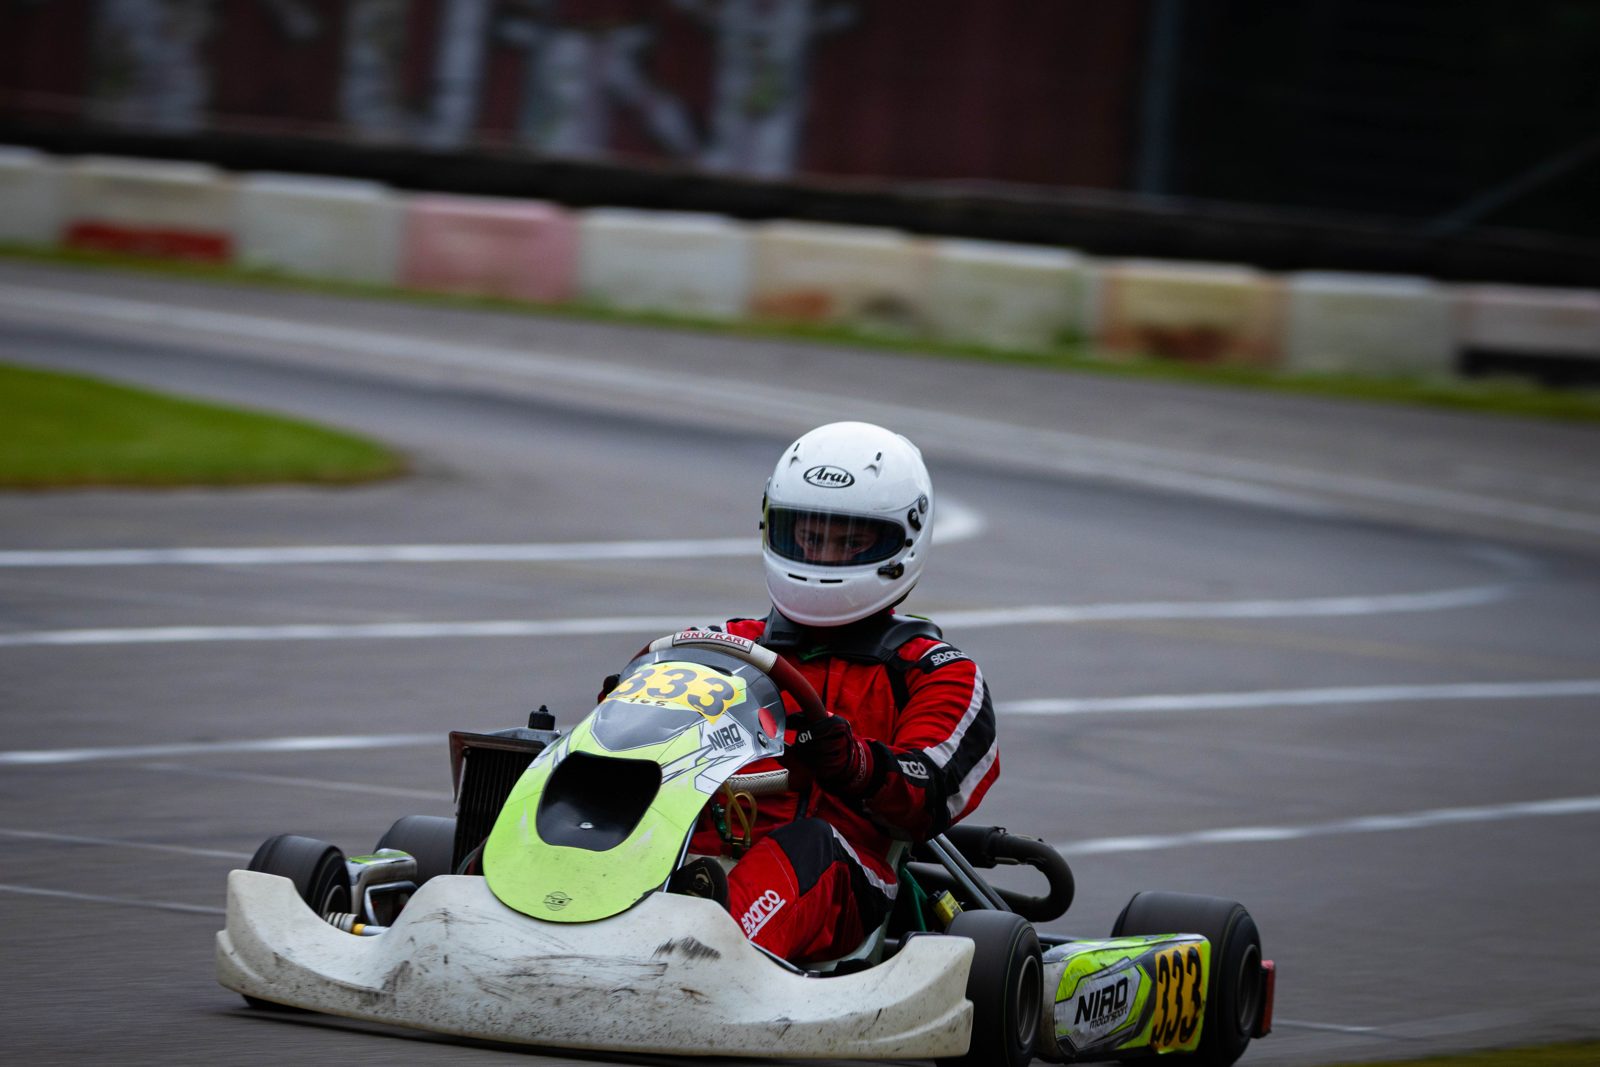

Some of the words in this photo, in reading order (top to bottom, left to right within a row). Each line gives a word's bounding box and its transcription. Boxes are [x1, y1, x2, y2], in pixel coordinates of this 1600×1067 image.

[806, 467, 849, 483] Arai
[607, 668, 735, 717] 333
[707, 723, 741, 751] NIRO
[741, 889, 784, 937] sparco
[1074, 977, 1128, 1025] NIRO
[1090, 1004, 1128, 1030] motorsport
[1150, 946, 1202, 1046] 333
